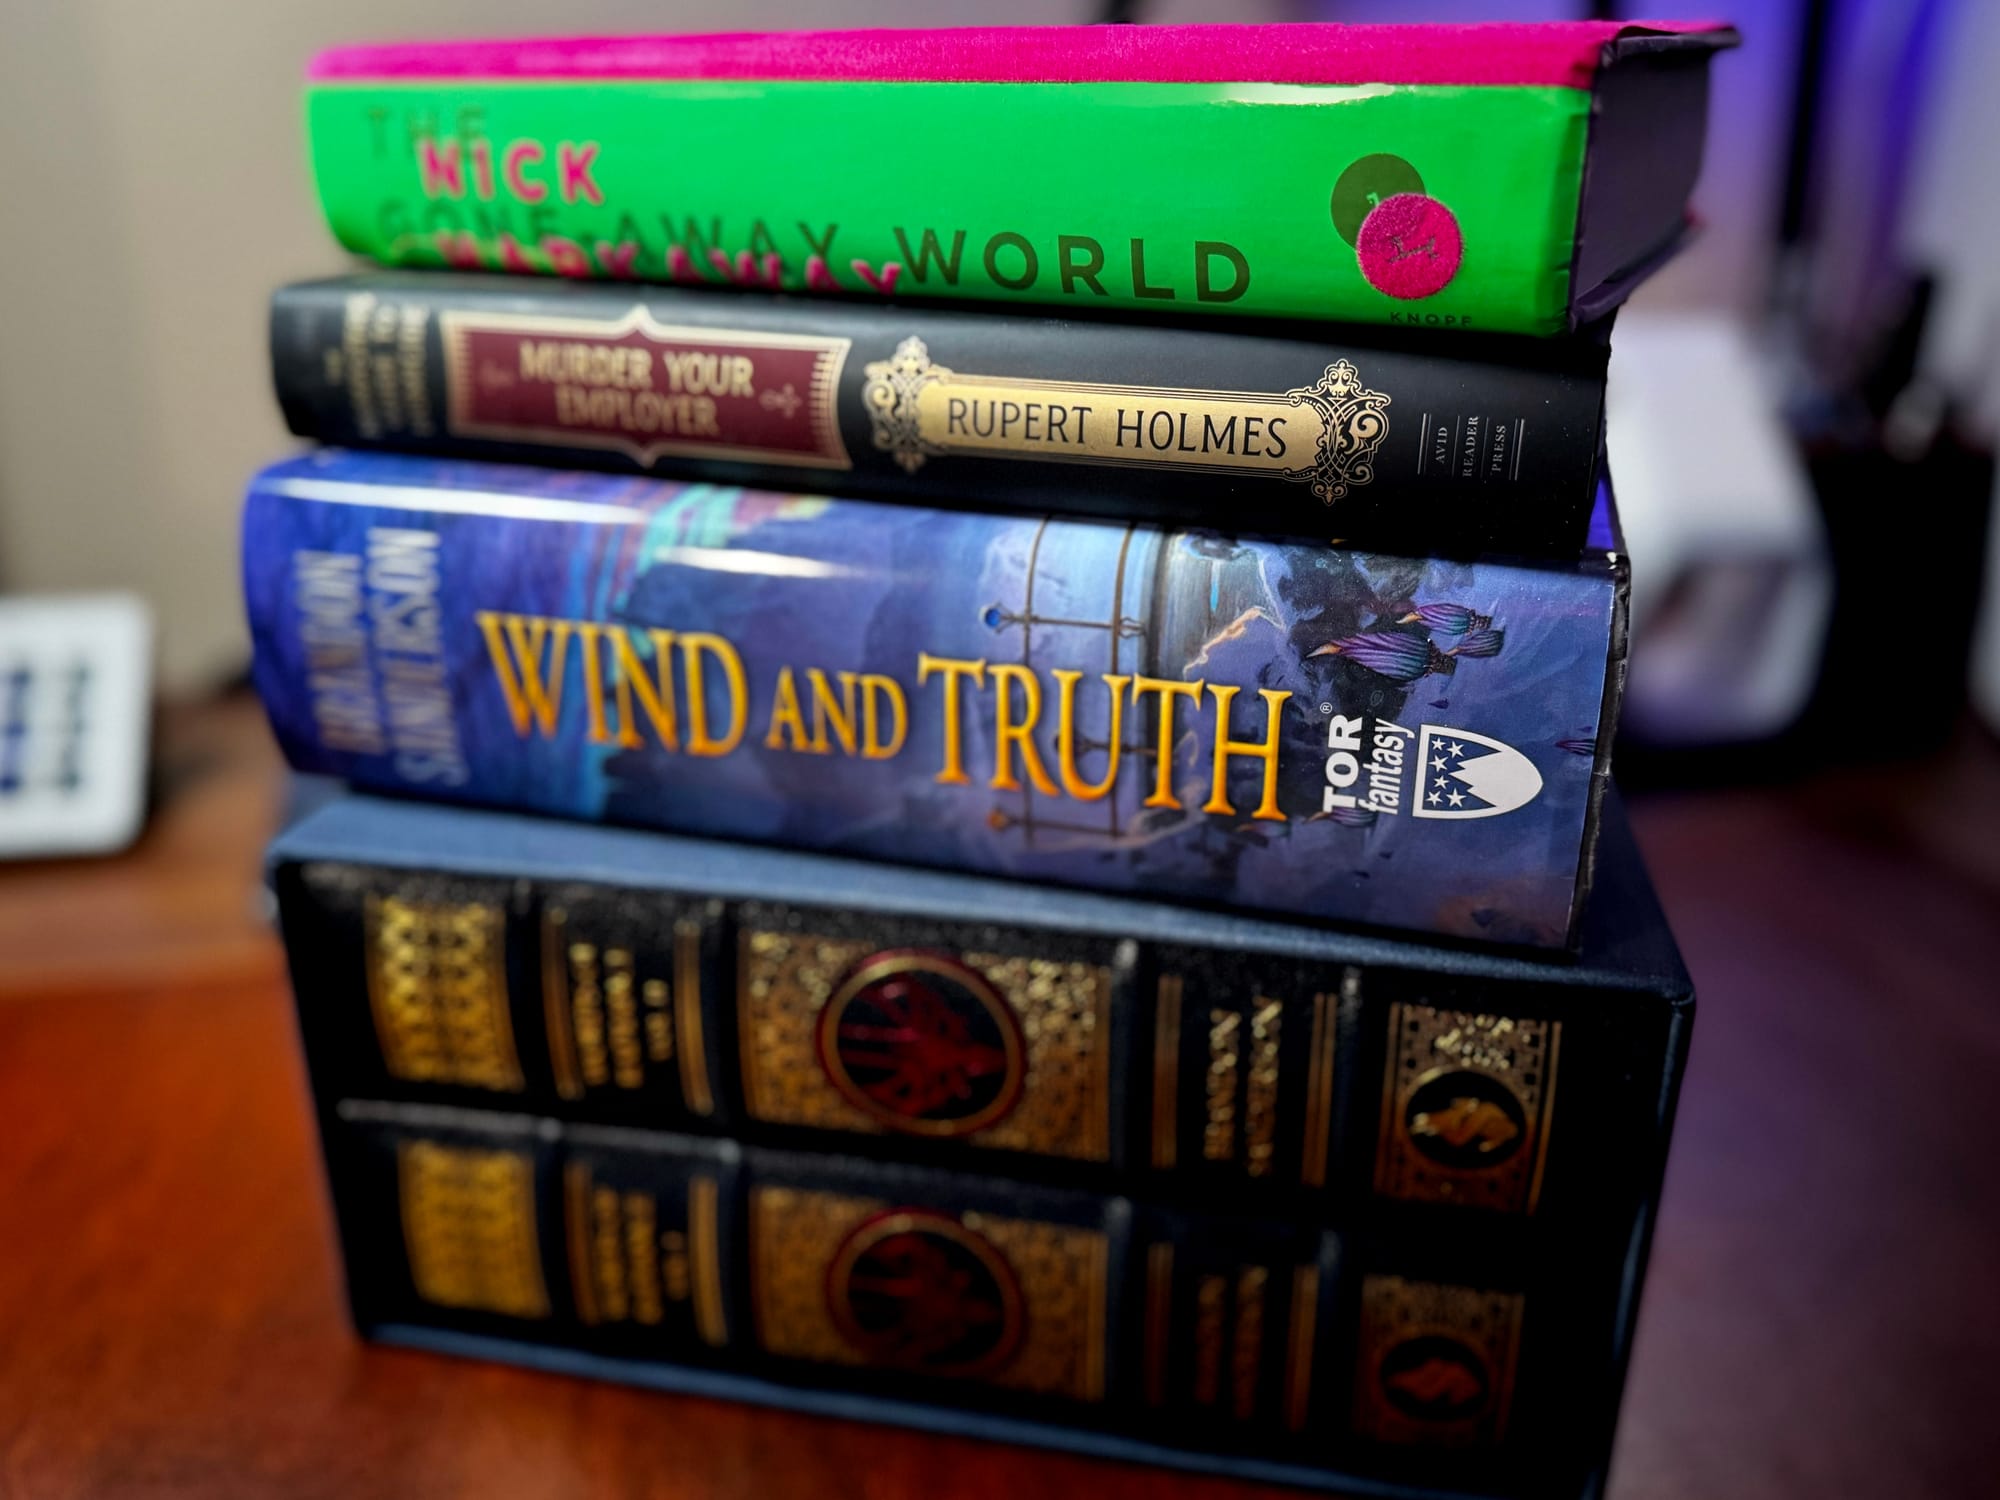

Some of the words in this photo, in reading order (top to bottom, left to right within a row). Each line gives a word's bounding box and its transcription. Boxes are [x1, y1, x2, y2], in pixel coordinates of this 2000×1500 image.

[366, 103, 490, 163] THE
[416, 136, 605, 205] NICK
[893, 226, 1252, 303] WORLD
[1389, 311, 1473, 327] KNOPF
[519, 340, 652, 391] MURDER
[664, 349, 755, 399] YOUR
[554, 384, 720, 437] EMPLOYER
[946, 396, 1093, 445] RUPERT
[1115, 408, 1288, 460] HOLMES
[1434, 426, 1449, 465] AVID
[1461, 415, 1480, 478] READER
[1490, 424, 1506, 473] PRESS
[476, 609, 748, 759] WIND
[765, 666, 908, 760] AND
[917, 652, 1294, 821] TRUTH
[1357, 717, 1416, 816] fantasy
